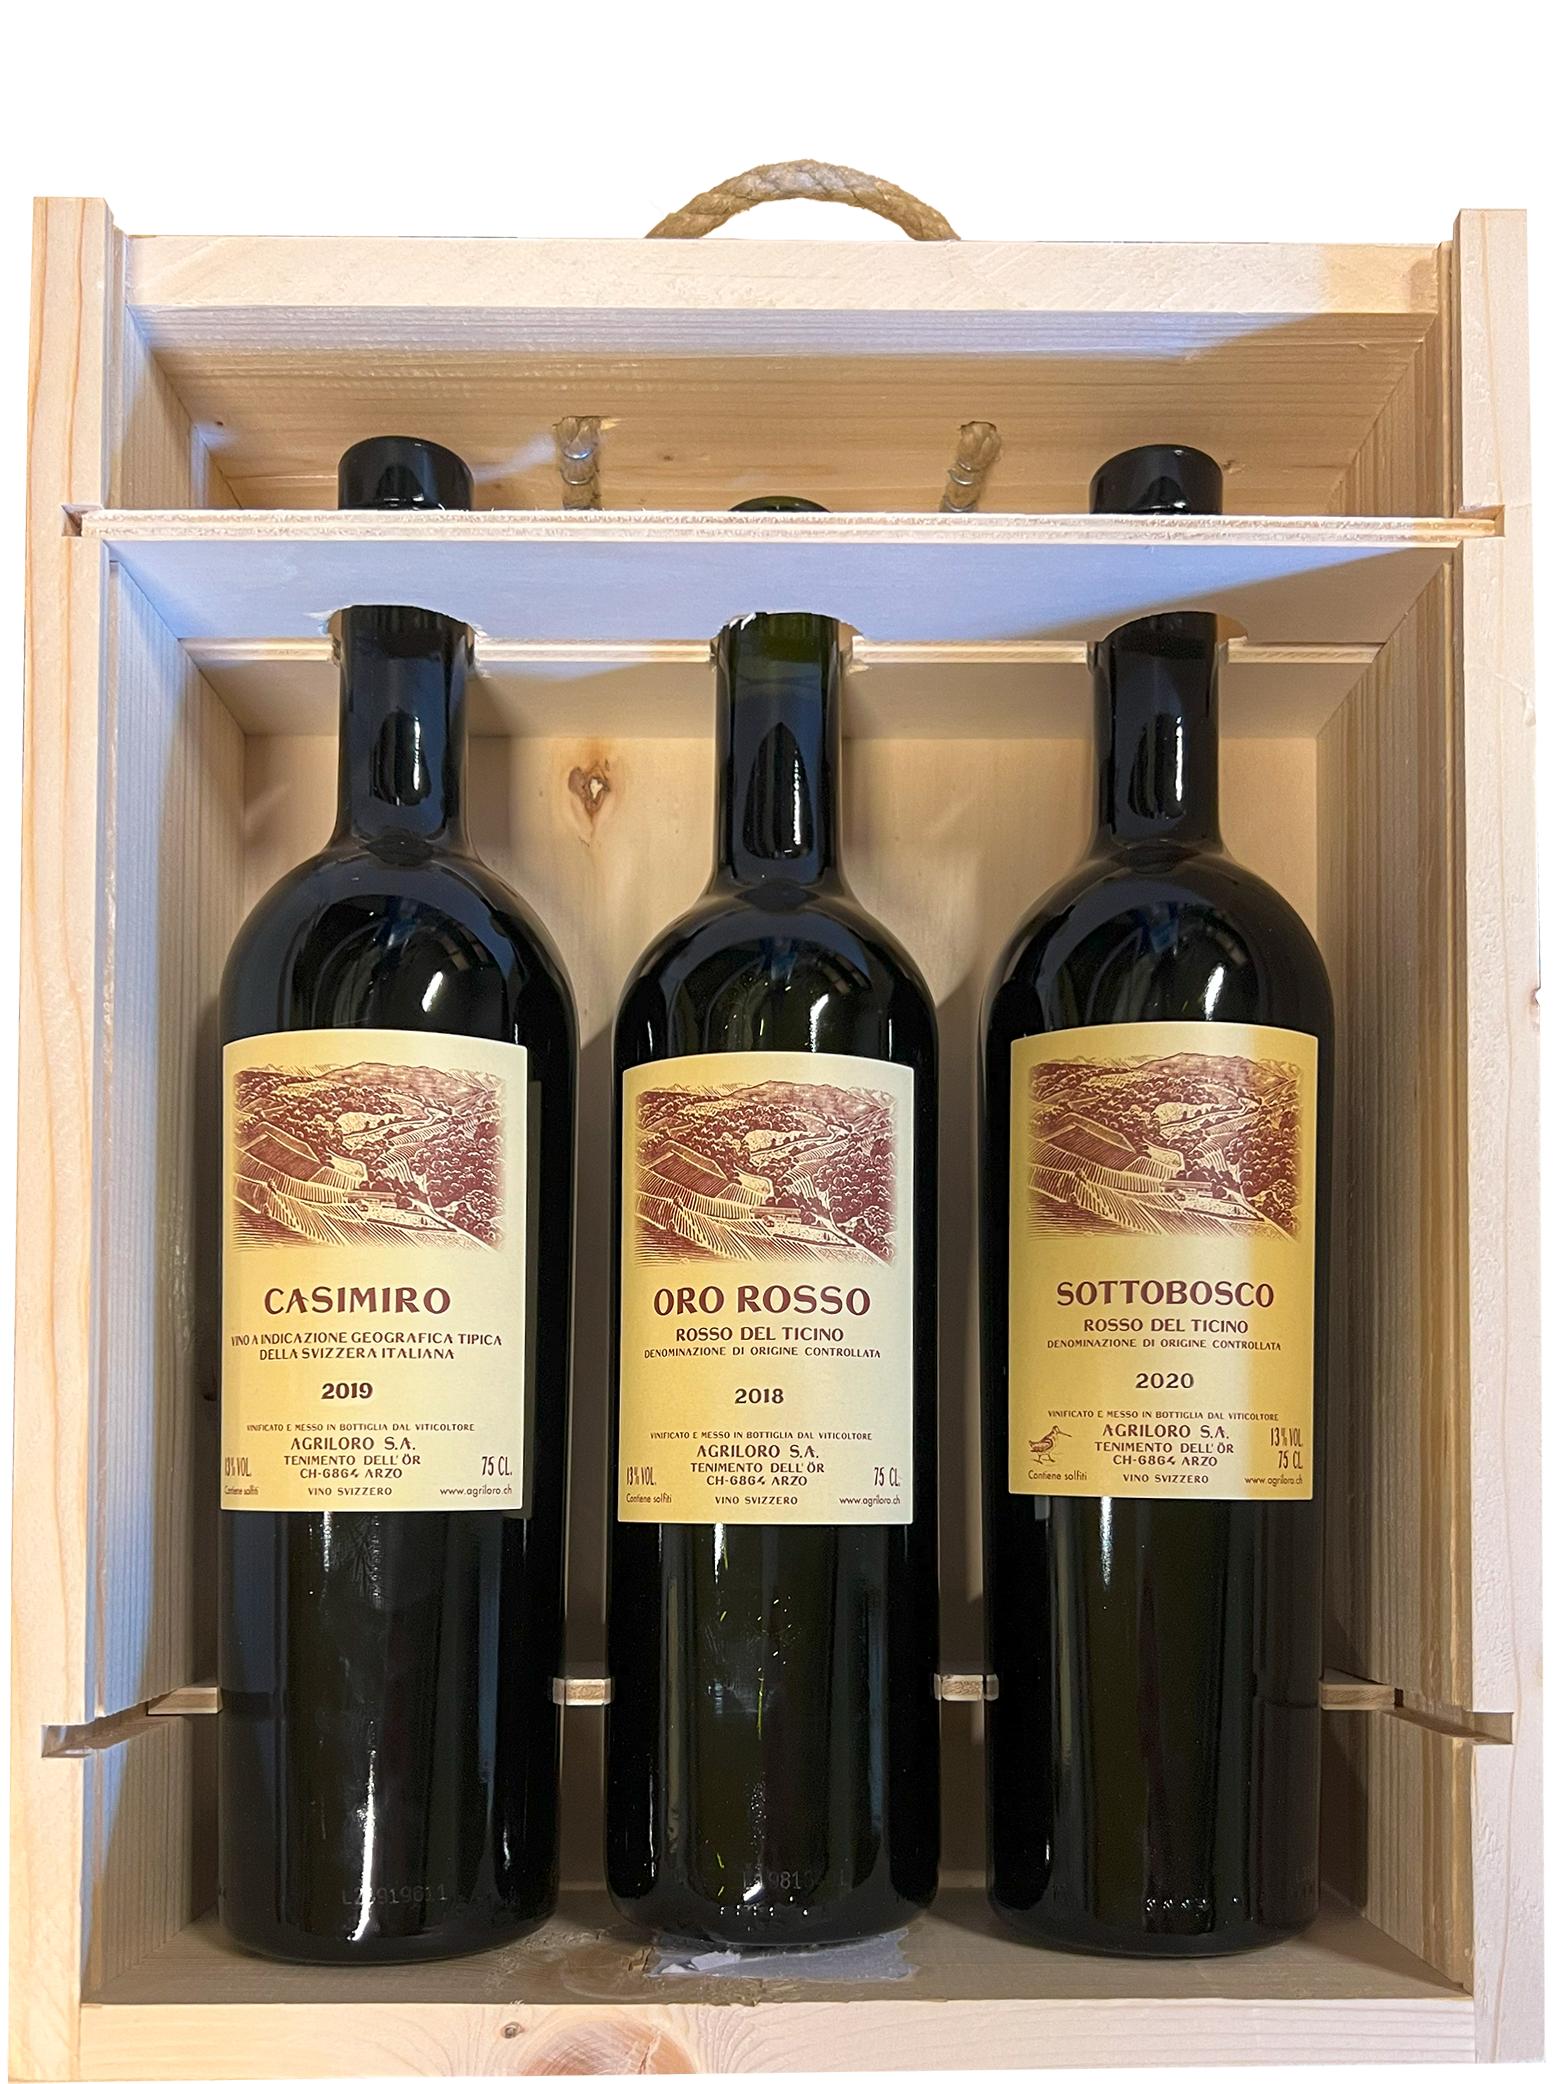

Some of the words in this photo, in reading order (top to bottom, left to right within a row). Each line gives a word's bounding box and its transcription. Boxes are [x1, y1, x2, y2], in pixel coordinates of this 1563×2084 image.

[264, 1286, 451, 1315] CASIMIRO
[653, 1286, 724, 1316] ORO
[737, 1285, 871, 1316] ROSSO
[1057, 1280, 1274, 1308] SOTTOBOSCO
[1084, 1318, 1143, 1332] ROSSO
[1150, 1318, 1185, 1332] DEL
[1191, 1319, 1249, 1334] TICINO
[231, 1334, 250, 1347] VINO
[251, 1334, 259, 1345] A
[261, 1332, 347, 1345] INDICAZIONE
[351, 1331, 453, 1344] GEOGRAFICA
[458, 1333, 502, 1346] TIPICA
[676, 1327, 733, 1342] ROSSO
[741, 1327, 776, 1341] DEL
[782, 1327, 844, 1342] TICINO
[1047, 1338, 1137, 1349] DENOMINAZIONE
[1143, 1339, 1155, 1348] DI
[1160, 1339, 1206, 1349] ORIGINE
[1212, 1340, 1281, 1351] CONTROLLATA
[260, 1348, 298, 1361] DELLA
[301, 1347, 377, 1359] SVIZZERA
[382, 1347, 455, 1360] ITALIANA
[644, 1347, 726, 1359] DENOMINAZIONE
[733, 1347, 745, 1356] DI
[750, 1347, 798, 1356] ORIGINE
[805, 1347, 881, 1359] CONTROLLATA
[1135, 1373, 1195, 1389] 2020
[321, 1382, 373, 1400] 2019
[734, 1388, 784, 1404] 2018
[1048, 1410, 1094, 1418] VINIFICATO
[1107, 1411, 1138, 1419] MESSO
[1142, 1411, 1152, 1419] IN
[1156, 1411, 1204, 1420] BOTTIGLIA
[1208, 1412, 1224, 1420] DAL
[1228, 1412, 1279, 1421] VITICOLTORE
[286, 1424, 292, 1432] E
[294, 1424, 323, 1432] MESSO
[339, 1423, 388, 1431] BOTTIGLIA
[392, 1423, 411, 1431] DAL
[415, 1423, 475, 1432] VITICOLTORE
[1103, 1424, 1191, 1438] AGRILORO
[1200, 1424, 1229, 1439] S.A.
[650, 1431, 690, 1440] VINIFICATO
[701, 1431, 731, 1440] MESSO
[733, 1431, 743, 1439] IN
[746, 1431, 793, 1440] BOTTIGLIA
[797, 1432, 814, 1440] DAL
[818, 1432, 872, 1441] VITICOLTORE
[1270, 1427, 1288, 1447] 13%
[290, 1437, 375, 1451] AGRILORO
[384, 1436, 416, 1451] S.A.
[1094, 1441, 1173, 1453] TENIMENTO
[696, 1444, 781, 1458] AGRILORO
[789, 1444, 819, 1459] S.A.
[283, 1455, 356, 1466] TENIMENTO
[481, 1456, 495, 1476] 75
[497, 1456, 513, 1476] CL.
[1112, 1454, 1176, 1466] CH-6864
[1181, 1456, 1218, 1467] ARZO
[1278, 1450, 1289, 1470] 75
[299, 1468, 359, 1479] CH-6864
[364, 1468, 403, 1479] ARZO
[690, 1462, 764, 1473] TENIMENTO
[626, 1466, 640, 1486] 13%
[640, 1466, 657, 1486] VOL.
[706, 1475, 766, 1486] CH-6864
[771, 1475, 808, 1487] ARZO
[873, 1466, 885, 1487] 75
[1028, 1470, 1062, 1480] Contiene
[1064, 1470, 1087, 1481] solfiti
[1122, 1474, 1149, 1483] VINO
[1154, 1474, 1209, 1484] SVIZZERO
[1244, 1474, 1303, 1487] www.agriloro.ch
[307, 1487, 332, 1496] VINO
[337, 1487, 393, 1496] SVIZZERO
[439, 1483, 513, 1498] www.agriloro.ch
[626, 1492, 652, 1503] Contiene
[714, 1496, 740, 1505] VINO
[744, 1496, 798, 1505] SVIZZERO
[838, 1494, 901, 1508] www.agriloro.ch
